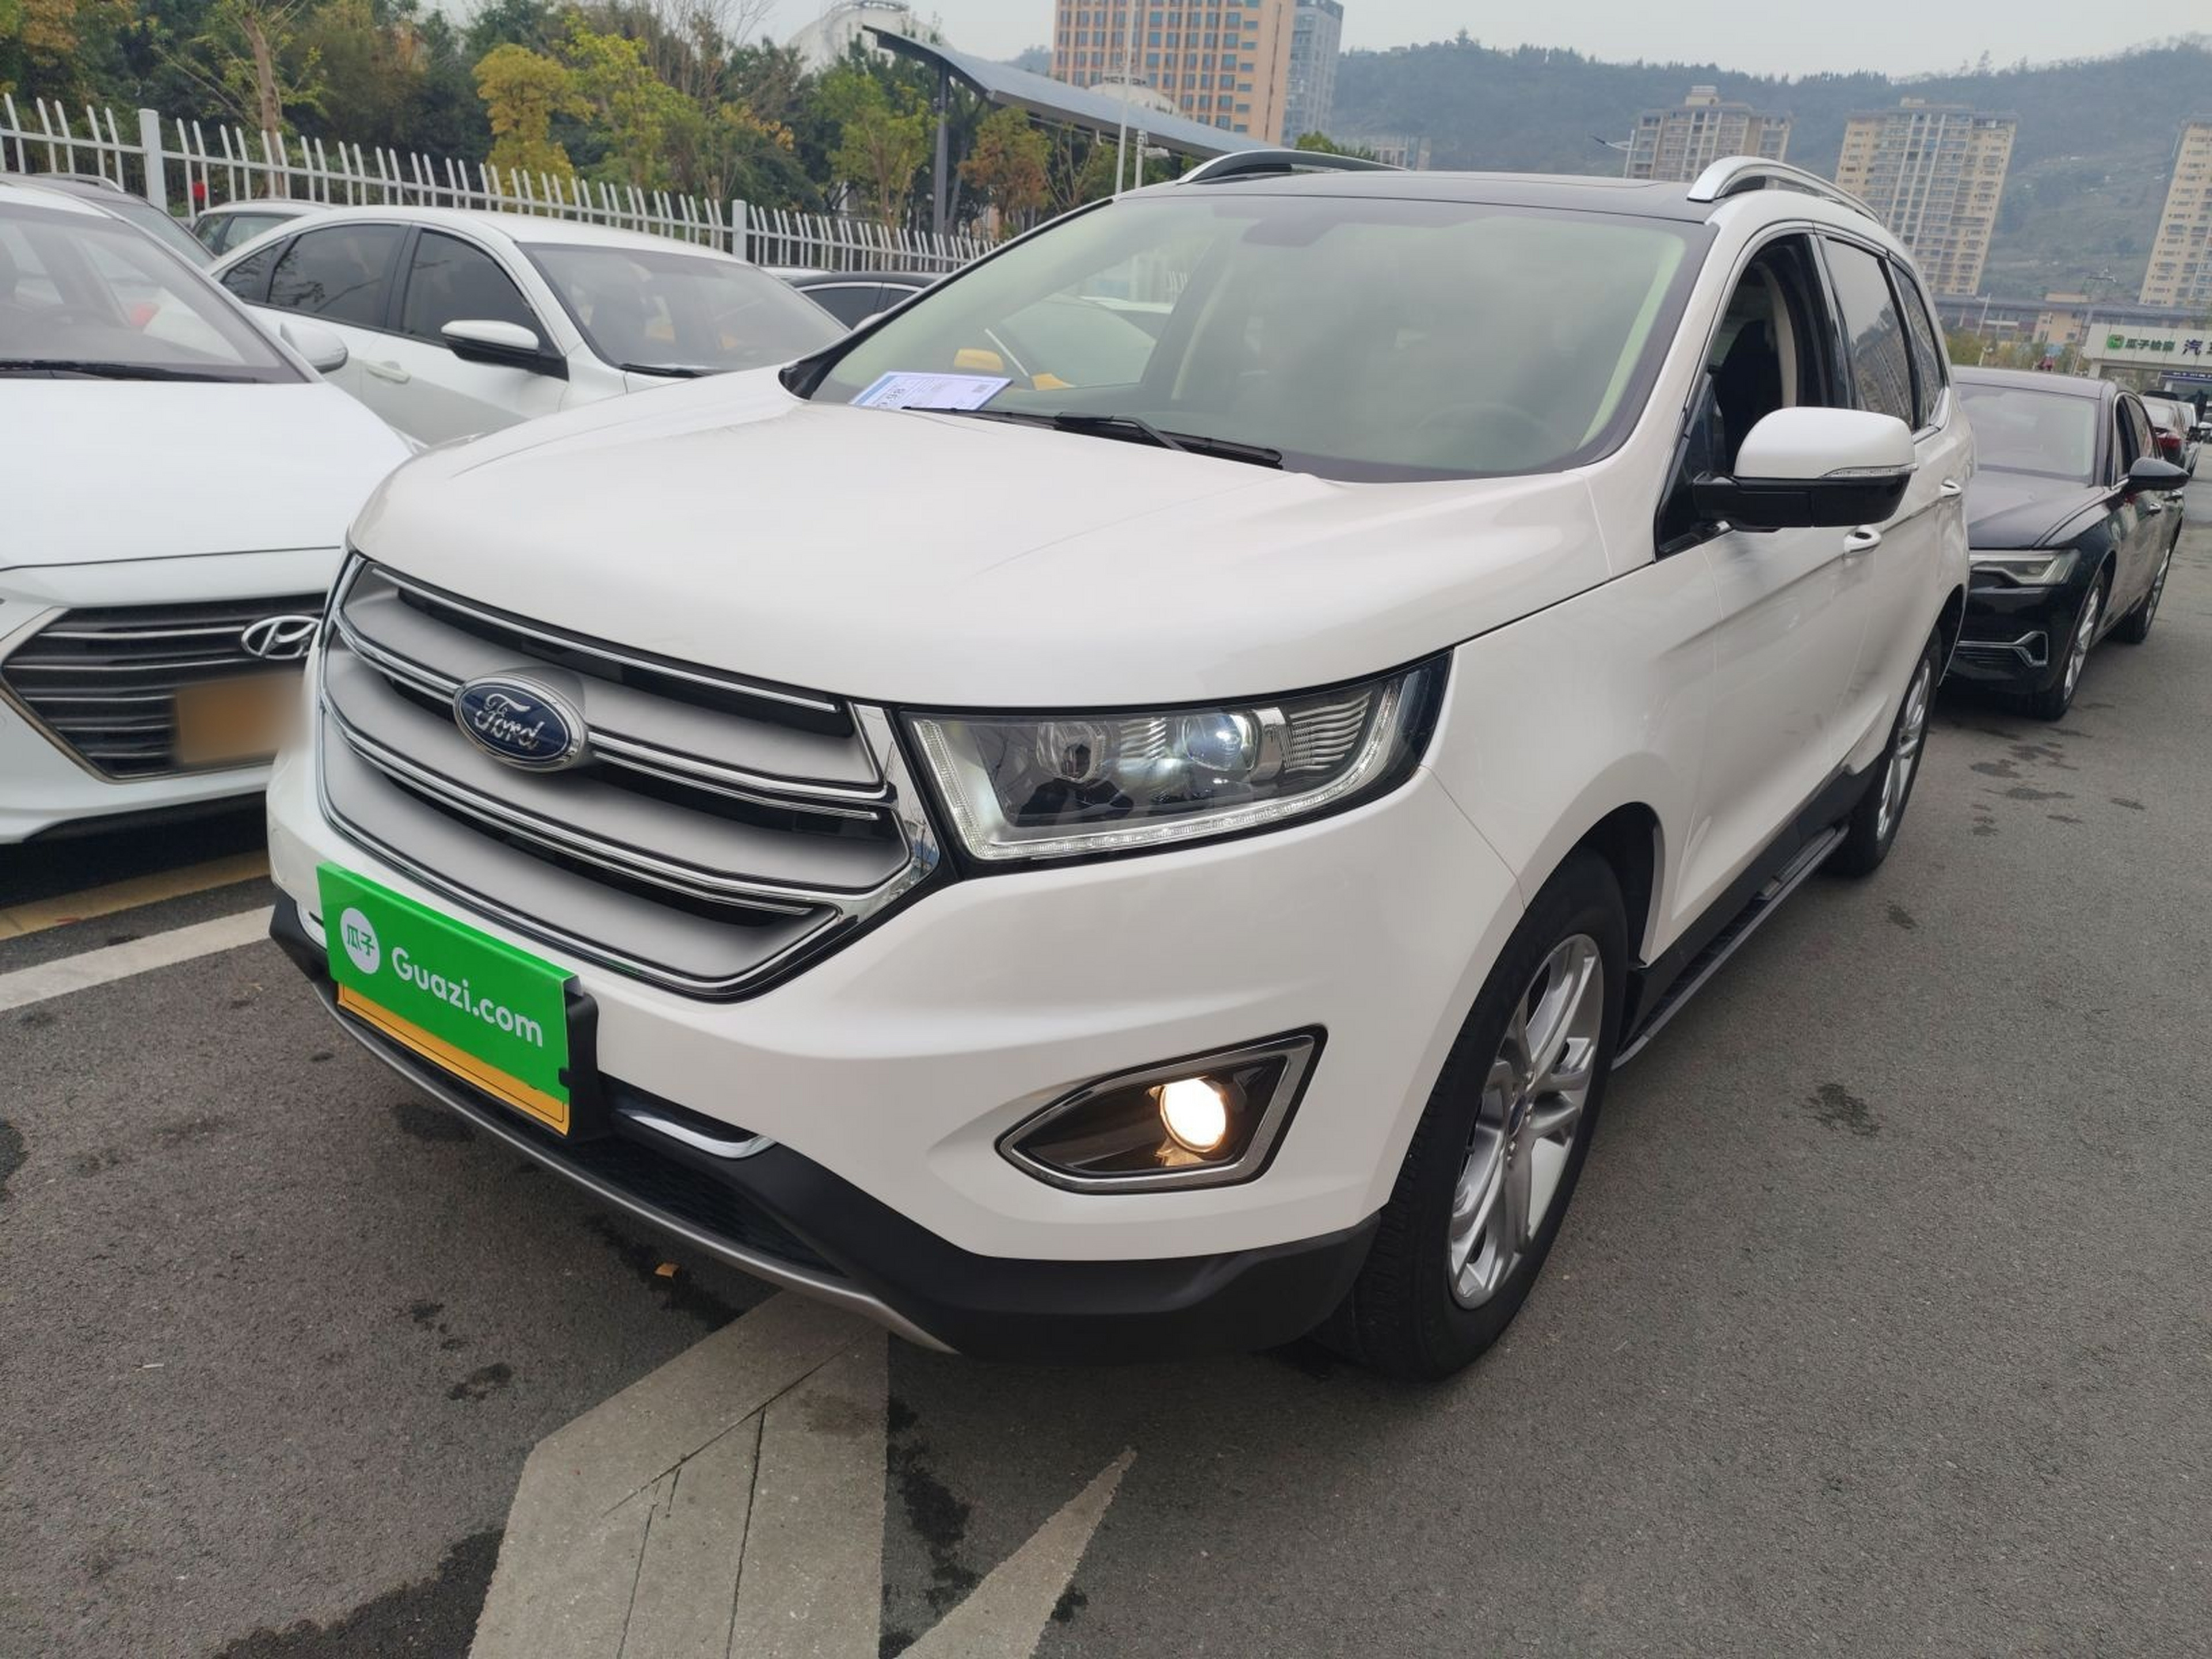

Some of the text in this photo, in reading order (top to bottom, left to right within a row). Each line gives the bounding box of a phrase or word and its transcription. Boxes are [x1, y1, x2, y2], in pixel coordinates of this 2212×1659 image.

[474, 693, 545, 749] Ford
[346, 924, 376, 956] 瓜子
[392, 948, 543, 1047] Guazi.com
